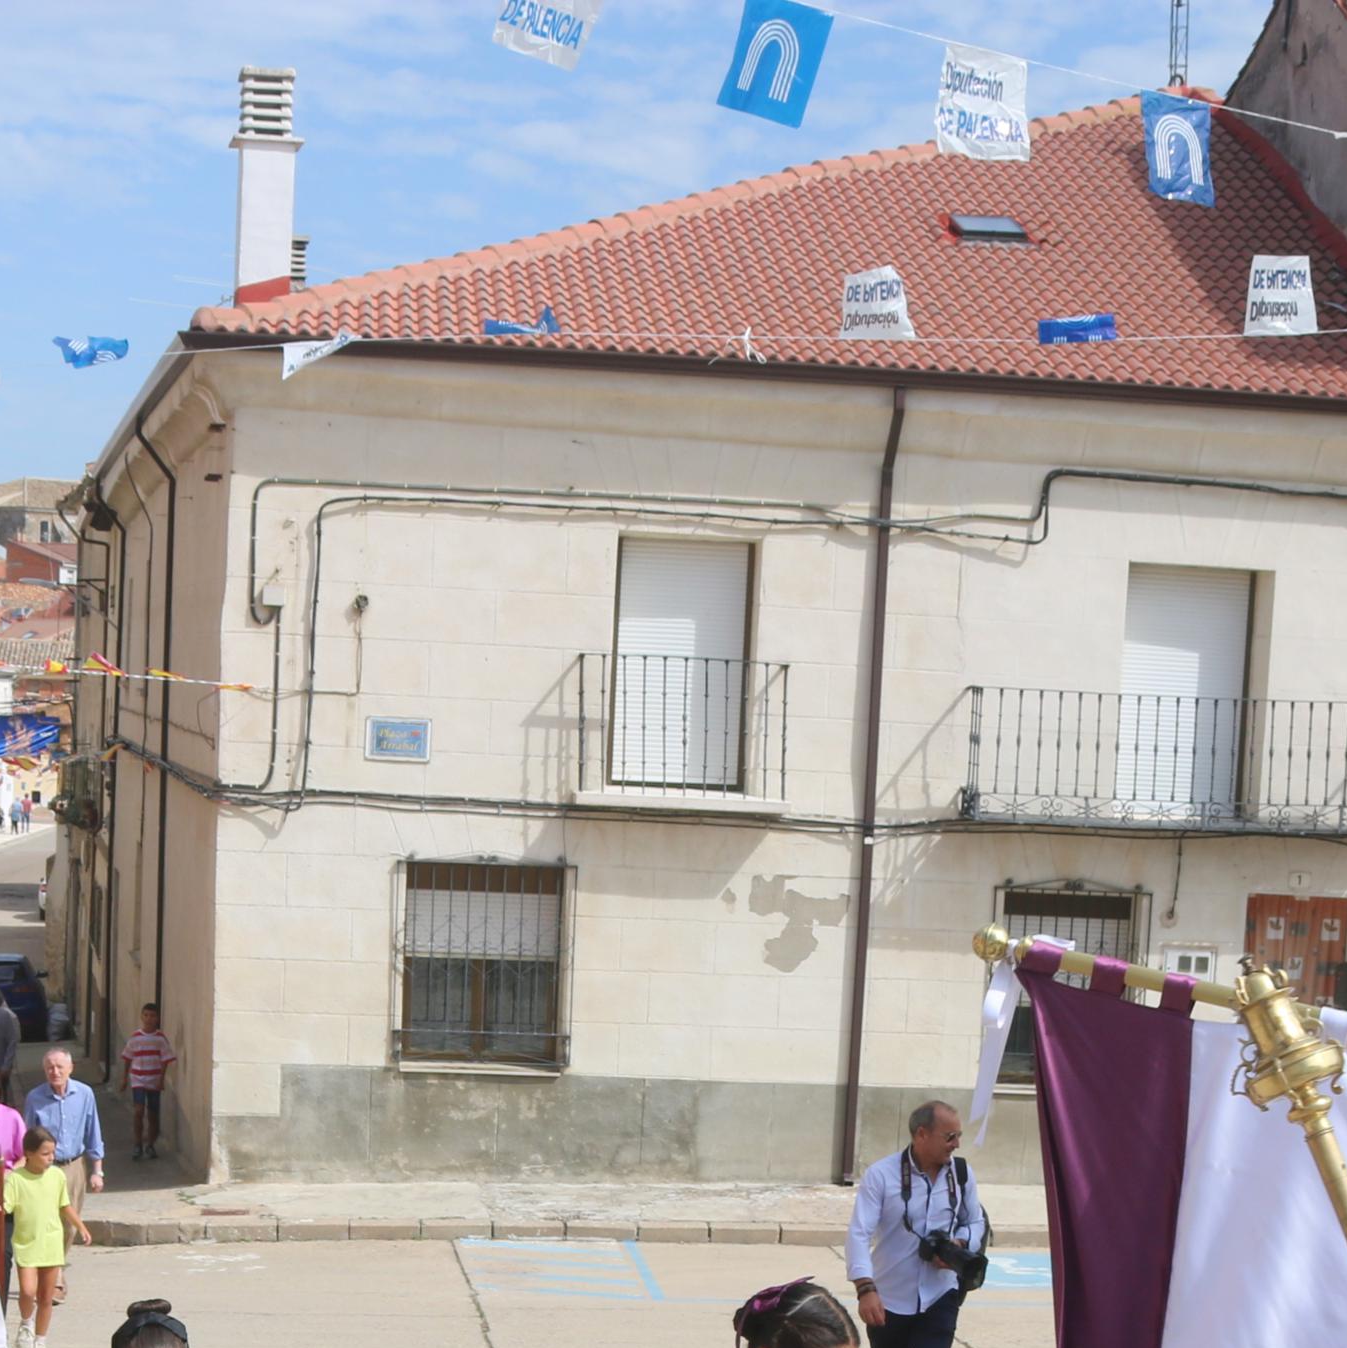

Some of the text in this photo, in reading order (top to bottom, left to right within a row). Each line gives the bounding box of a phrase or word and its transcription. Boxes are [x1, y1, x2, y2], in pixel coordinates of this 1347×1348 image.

[499, 0, 527, 26] DE
[945, 61, 1004, 102] Diputación
[938, 106, 955, 136] DE
